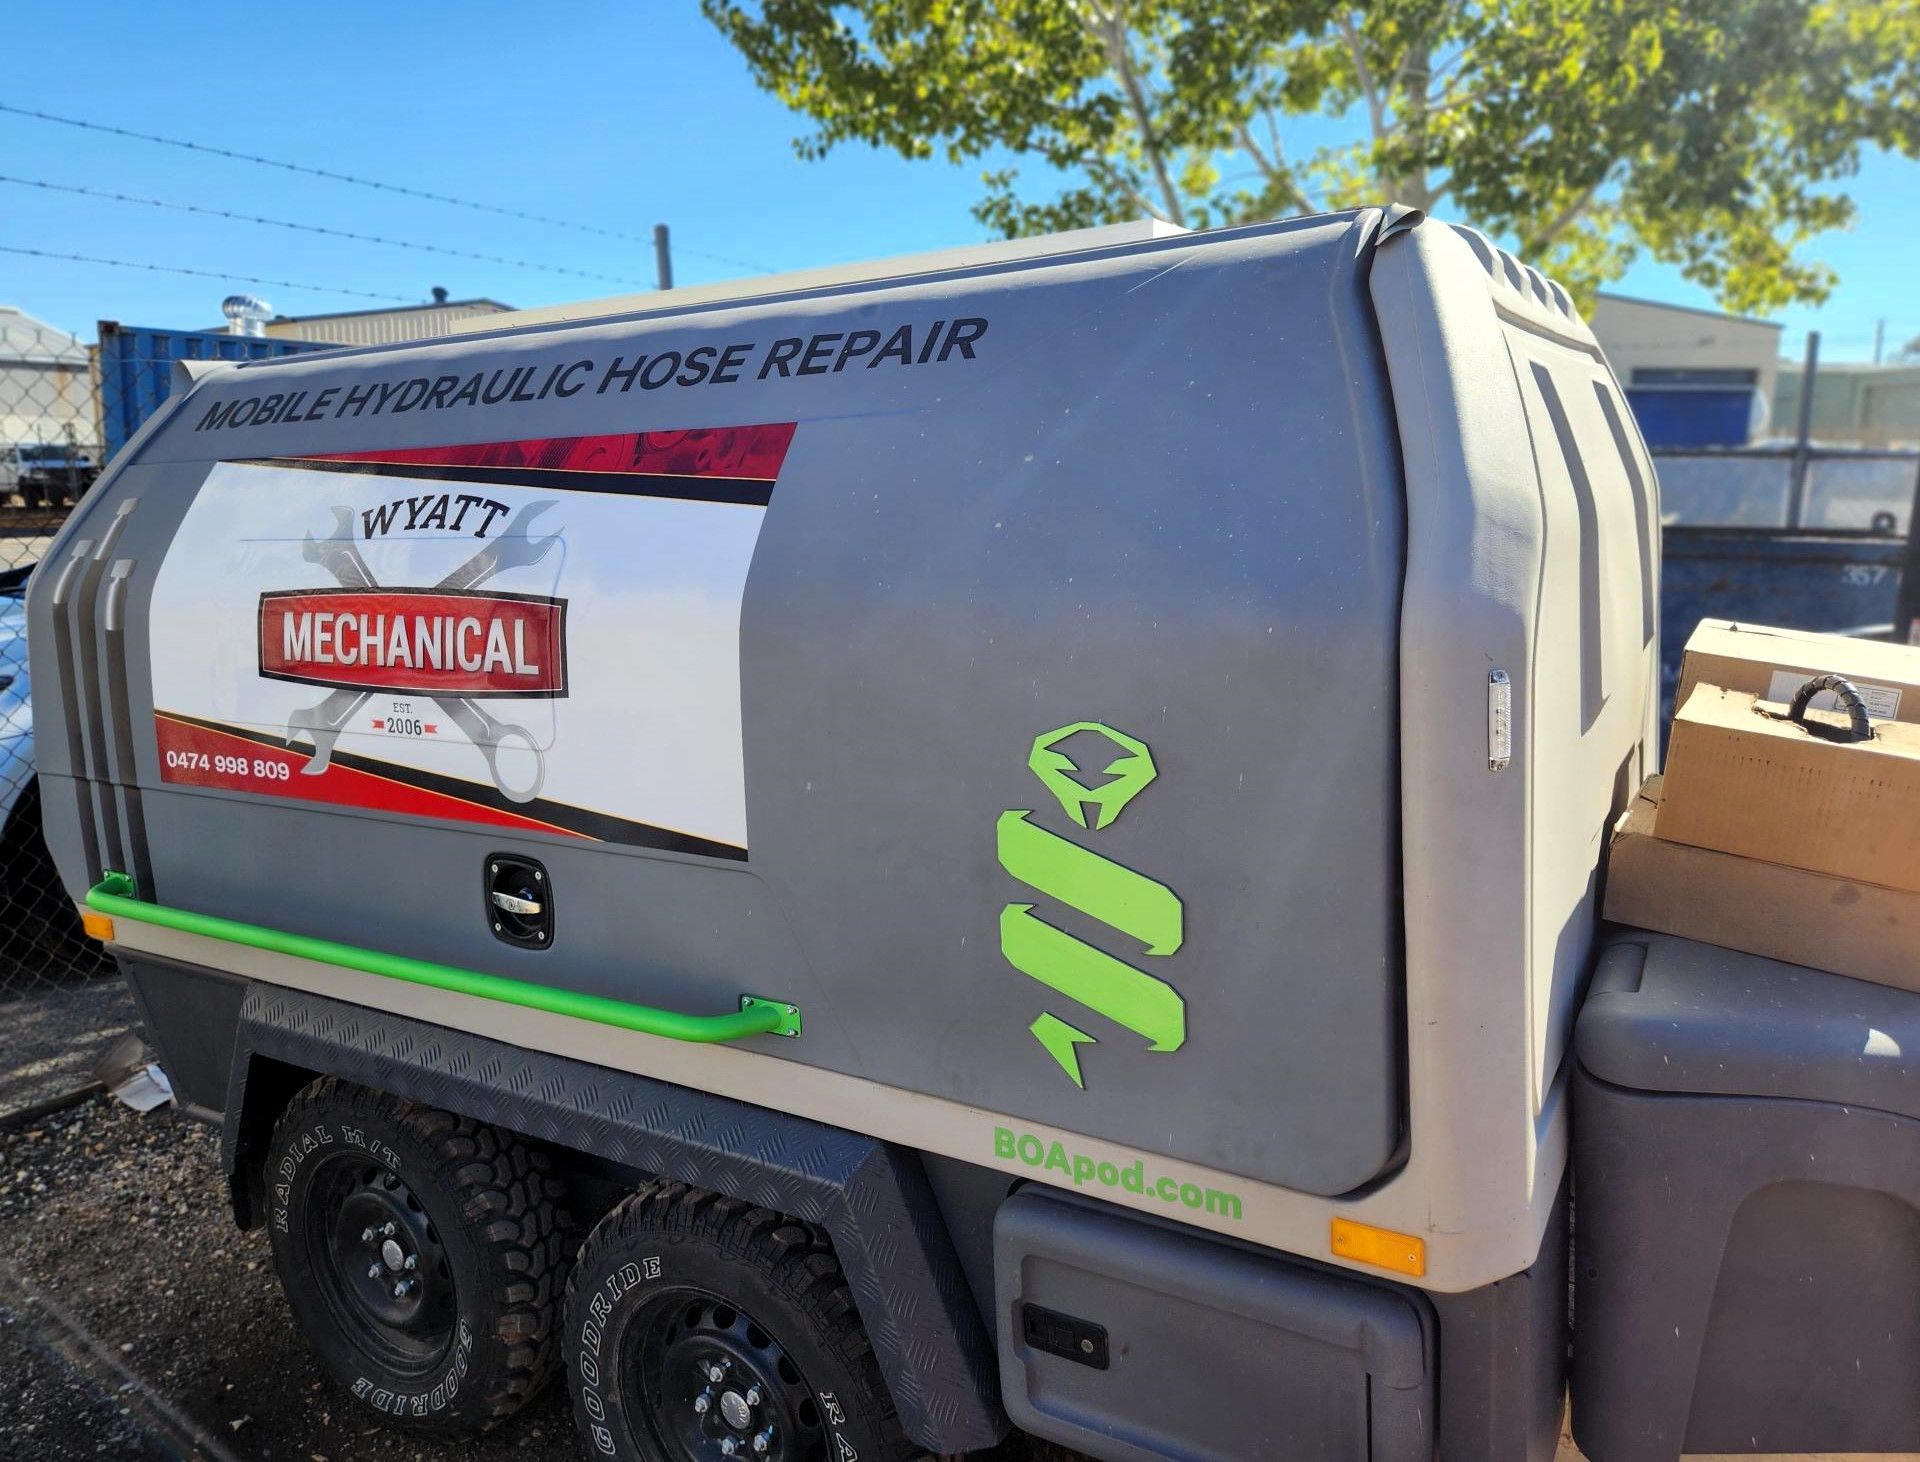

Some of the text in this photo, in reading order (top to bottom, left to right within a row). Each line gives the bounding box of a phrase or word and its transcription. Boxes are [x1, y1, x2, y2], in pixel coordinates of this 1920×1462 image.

[194, 317, 989, 432] MOBILE HYDRAULIC HOSE REPAIR
[361, 494, 511, 540] WYATT
[282, 611, 540, 676] MECHANICAL
[387, 717, 422, 736] 2006
[393, 702, 413, 714] EST.
[166, 750, 290, 781] 0474 998 809
[275, 1125, 333, 1233] RADIAL
[994, 1126, 1242, 1220] BOApod.com
[350, 1318, 473, 1416] GOODRIDE
[581, 1256, 662, 1455] GOODRIDE
